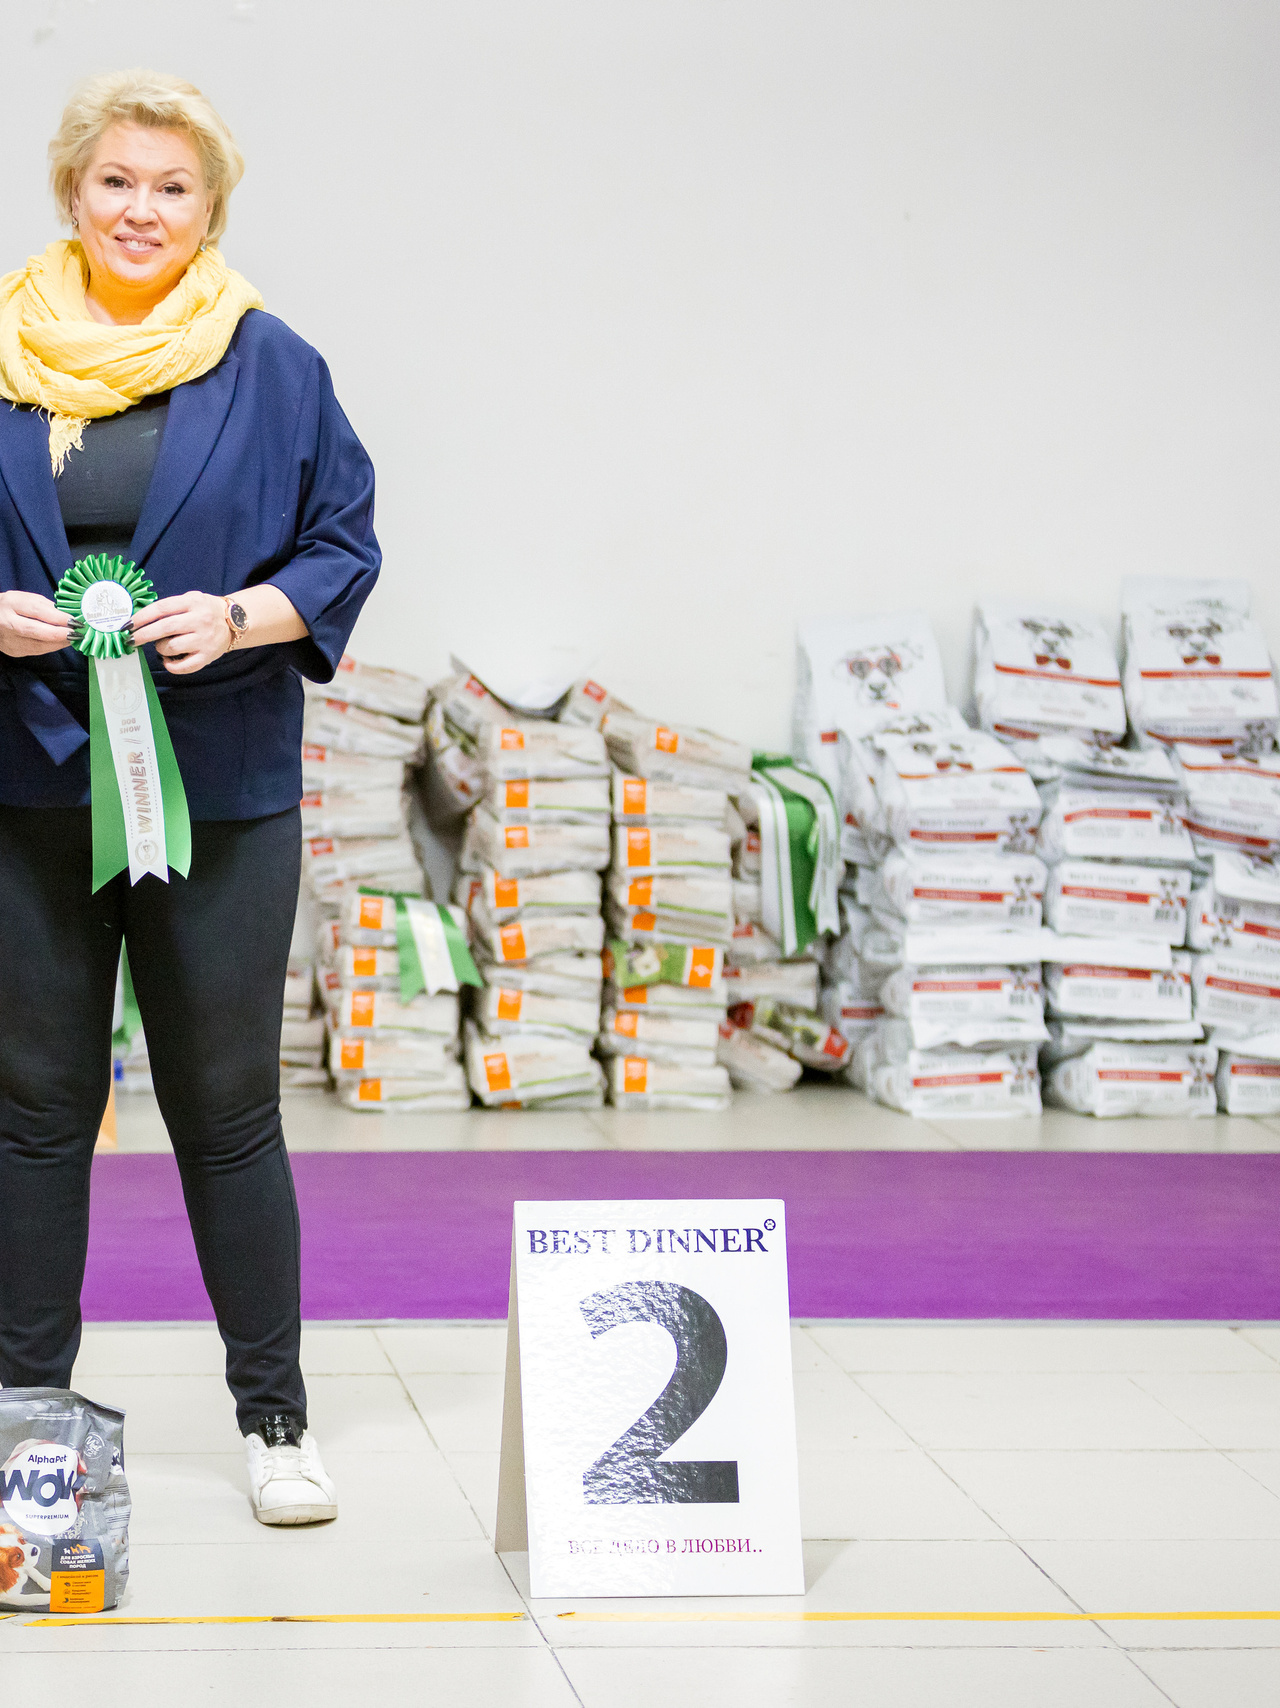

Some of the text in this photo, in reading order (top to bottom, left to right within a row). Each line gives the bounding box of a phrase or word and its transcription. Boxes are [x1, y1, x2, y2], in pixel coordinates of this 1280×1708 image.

[127, 750, 154, 835] WINNER
[527, 1228, 768, 1254] BEST DINNER
[579, 1280, 740, 1505] 2
[27, 1454, 68, 1465] AlphaPet
[25, 1513, 70, 1521] SUPERPREMIUM
[666, 1539, 677, 1554] В
[681, 1538, 763, 1554] ЛЮБВИ..
